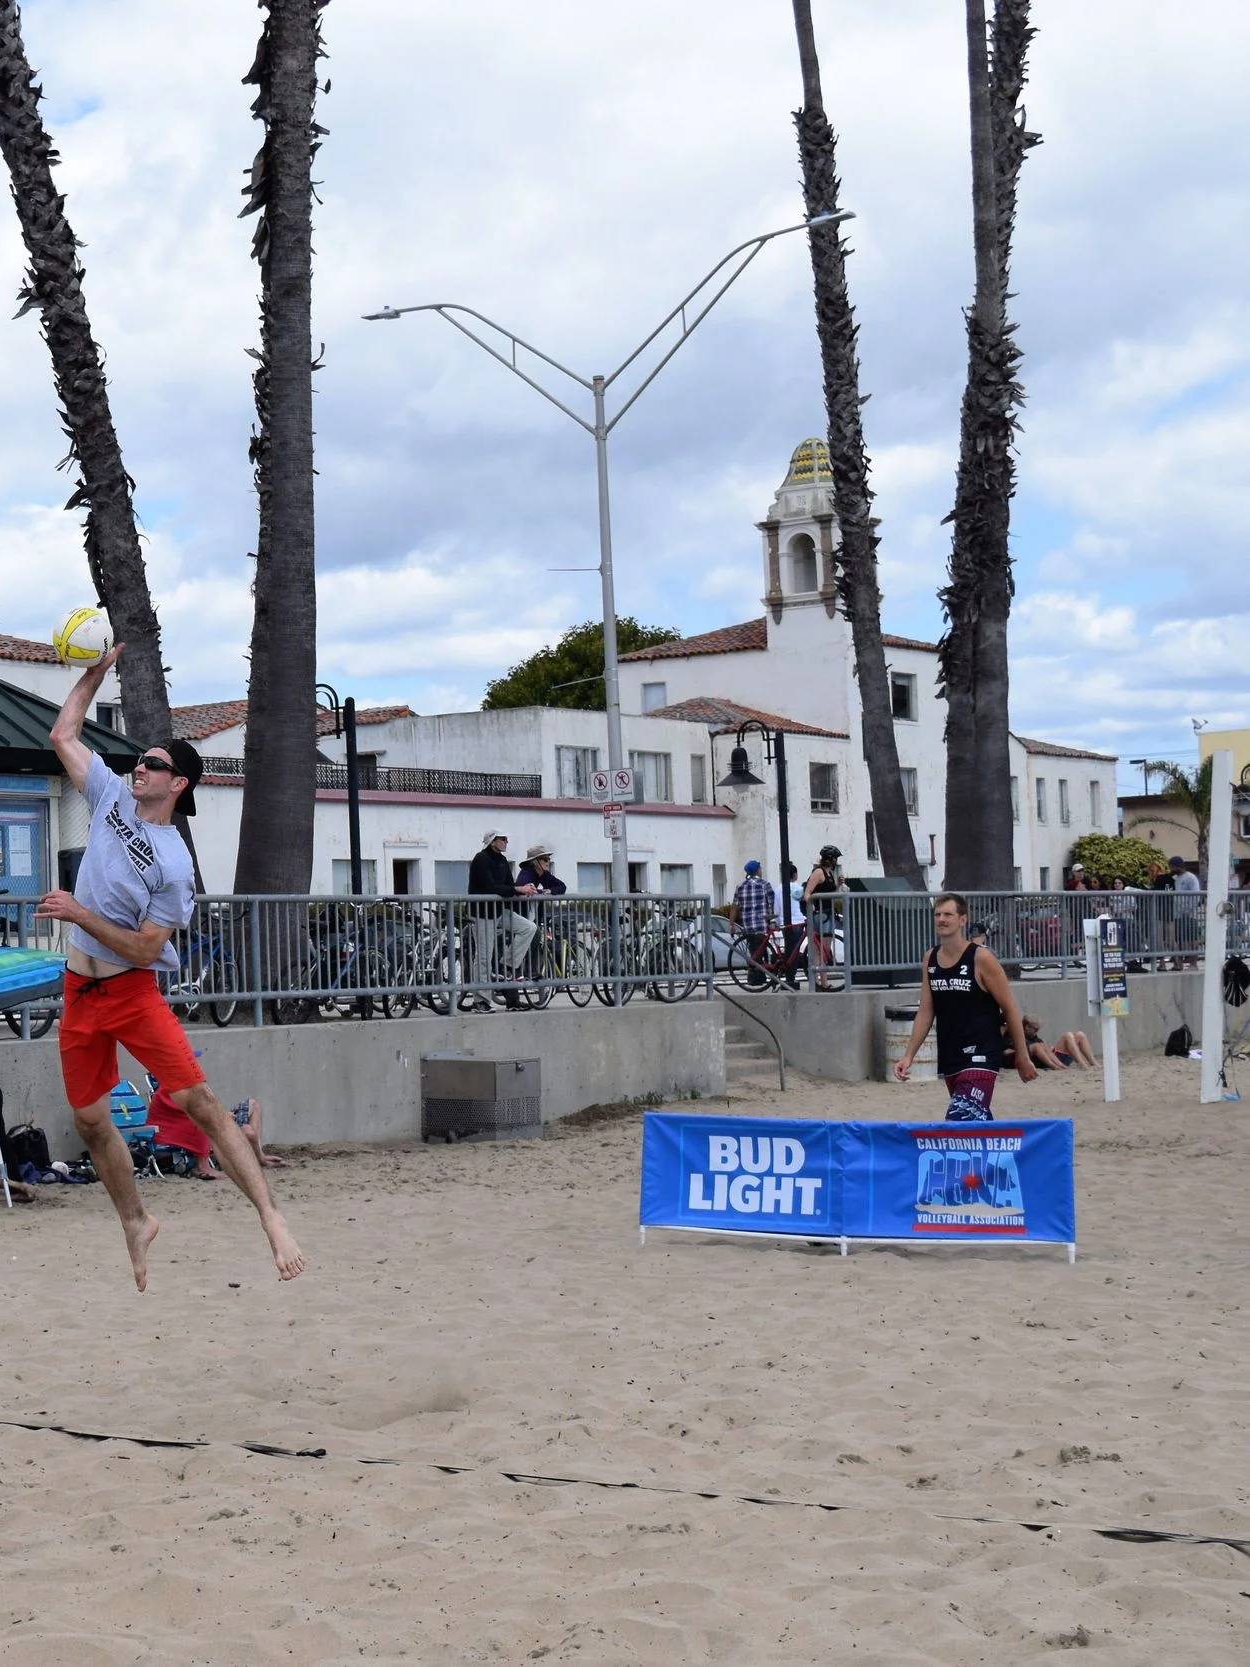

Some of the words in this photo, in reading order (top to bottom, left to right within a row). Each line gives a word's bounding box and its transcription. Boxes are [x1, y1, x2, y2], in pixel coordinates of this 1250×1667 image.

[959, 964, 968, 975] 2
[949, 978, 971, 987] CRUZ
[970, 1087, 985, 1102] USA
[917, 1137, 983, 1150] CALIFORNIA
[986, 1137, 1022, 1151] BEACH
[709, 1135, 805, 1174] BUD
[689, 1174, 822, 1216] LIGHT
[917, 1213, 966, 1225] VOLLEYBALL
[969, 1215, 1025, 1226] ASSOCIATION
